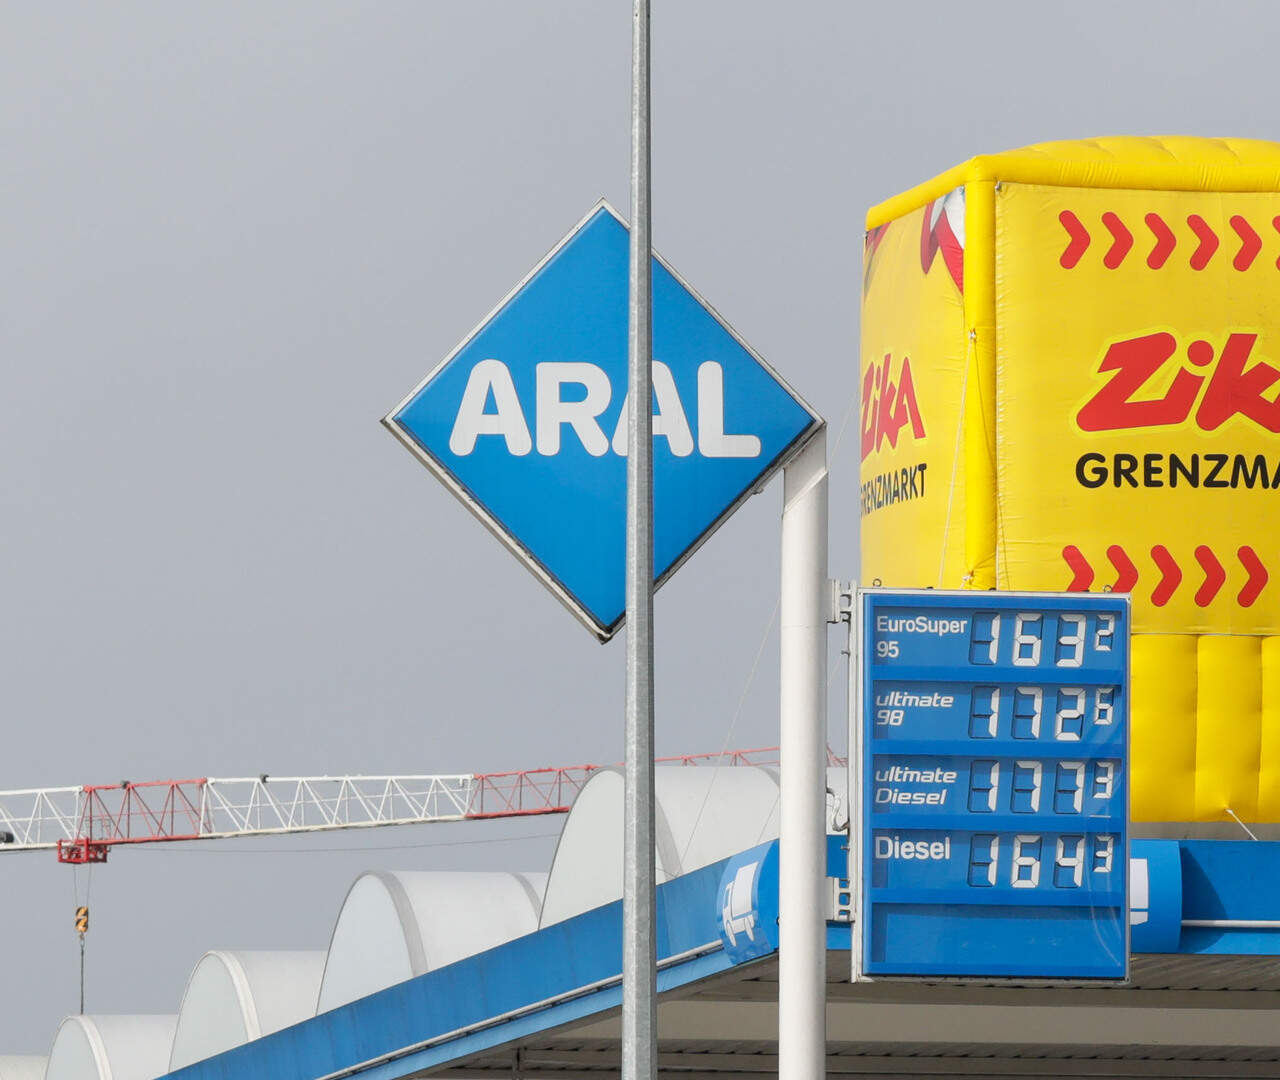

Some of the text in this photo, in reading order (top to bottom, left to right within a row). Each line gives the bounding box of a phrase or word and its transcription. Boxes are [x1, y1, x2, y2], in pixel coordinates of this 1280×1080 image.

[448, 358, 762, 458] ARAL
[861, 462, 927, 519] RENZMARKT
[876, 615, 968, 634] EuroSuper
[876, 640, 900, 659] 95
[875, 689, 954, 708] ultimate
[876, 710, 904, 726] 98
[875, 765, 957, 784] ultimate
[875, 787, 947, 805] Diesel
[874, 835, 951, 861] Diesel
